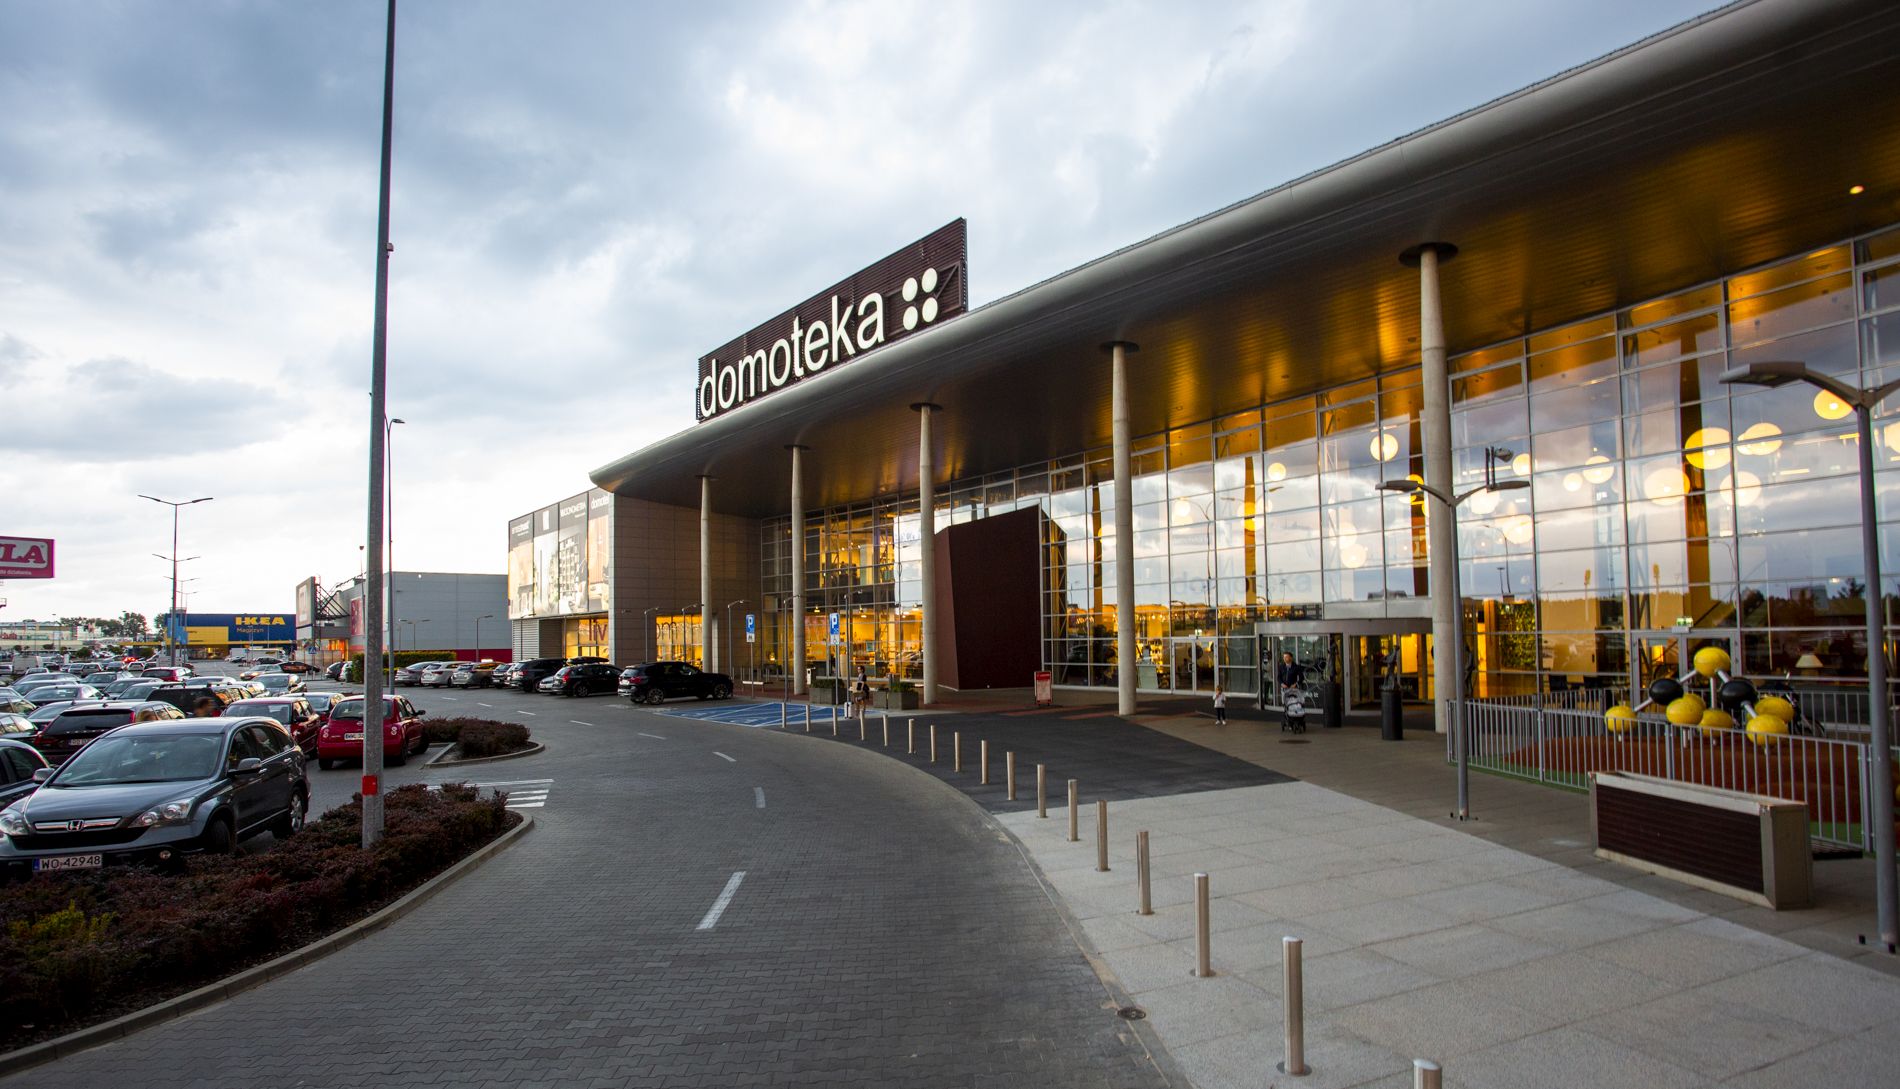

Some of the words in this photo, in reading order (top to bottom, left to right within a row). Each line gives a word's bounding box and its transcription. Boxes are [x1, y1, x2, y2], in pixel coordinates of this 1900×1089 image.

[700, 292, 885, 417] domoteka
[235, 616, 286, 625] IKEA
[747, 616, 753, 628] P
[831, 615, 838, 629] P
